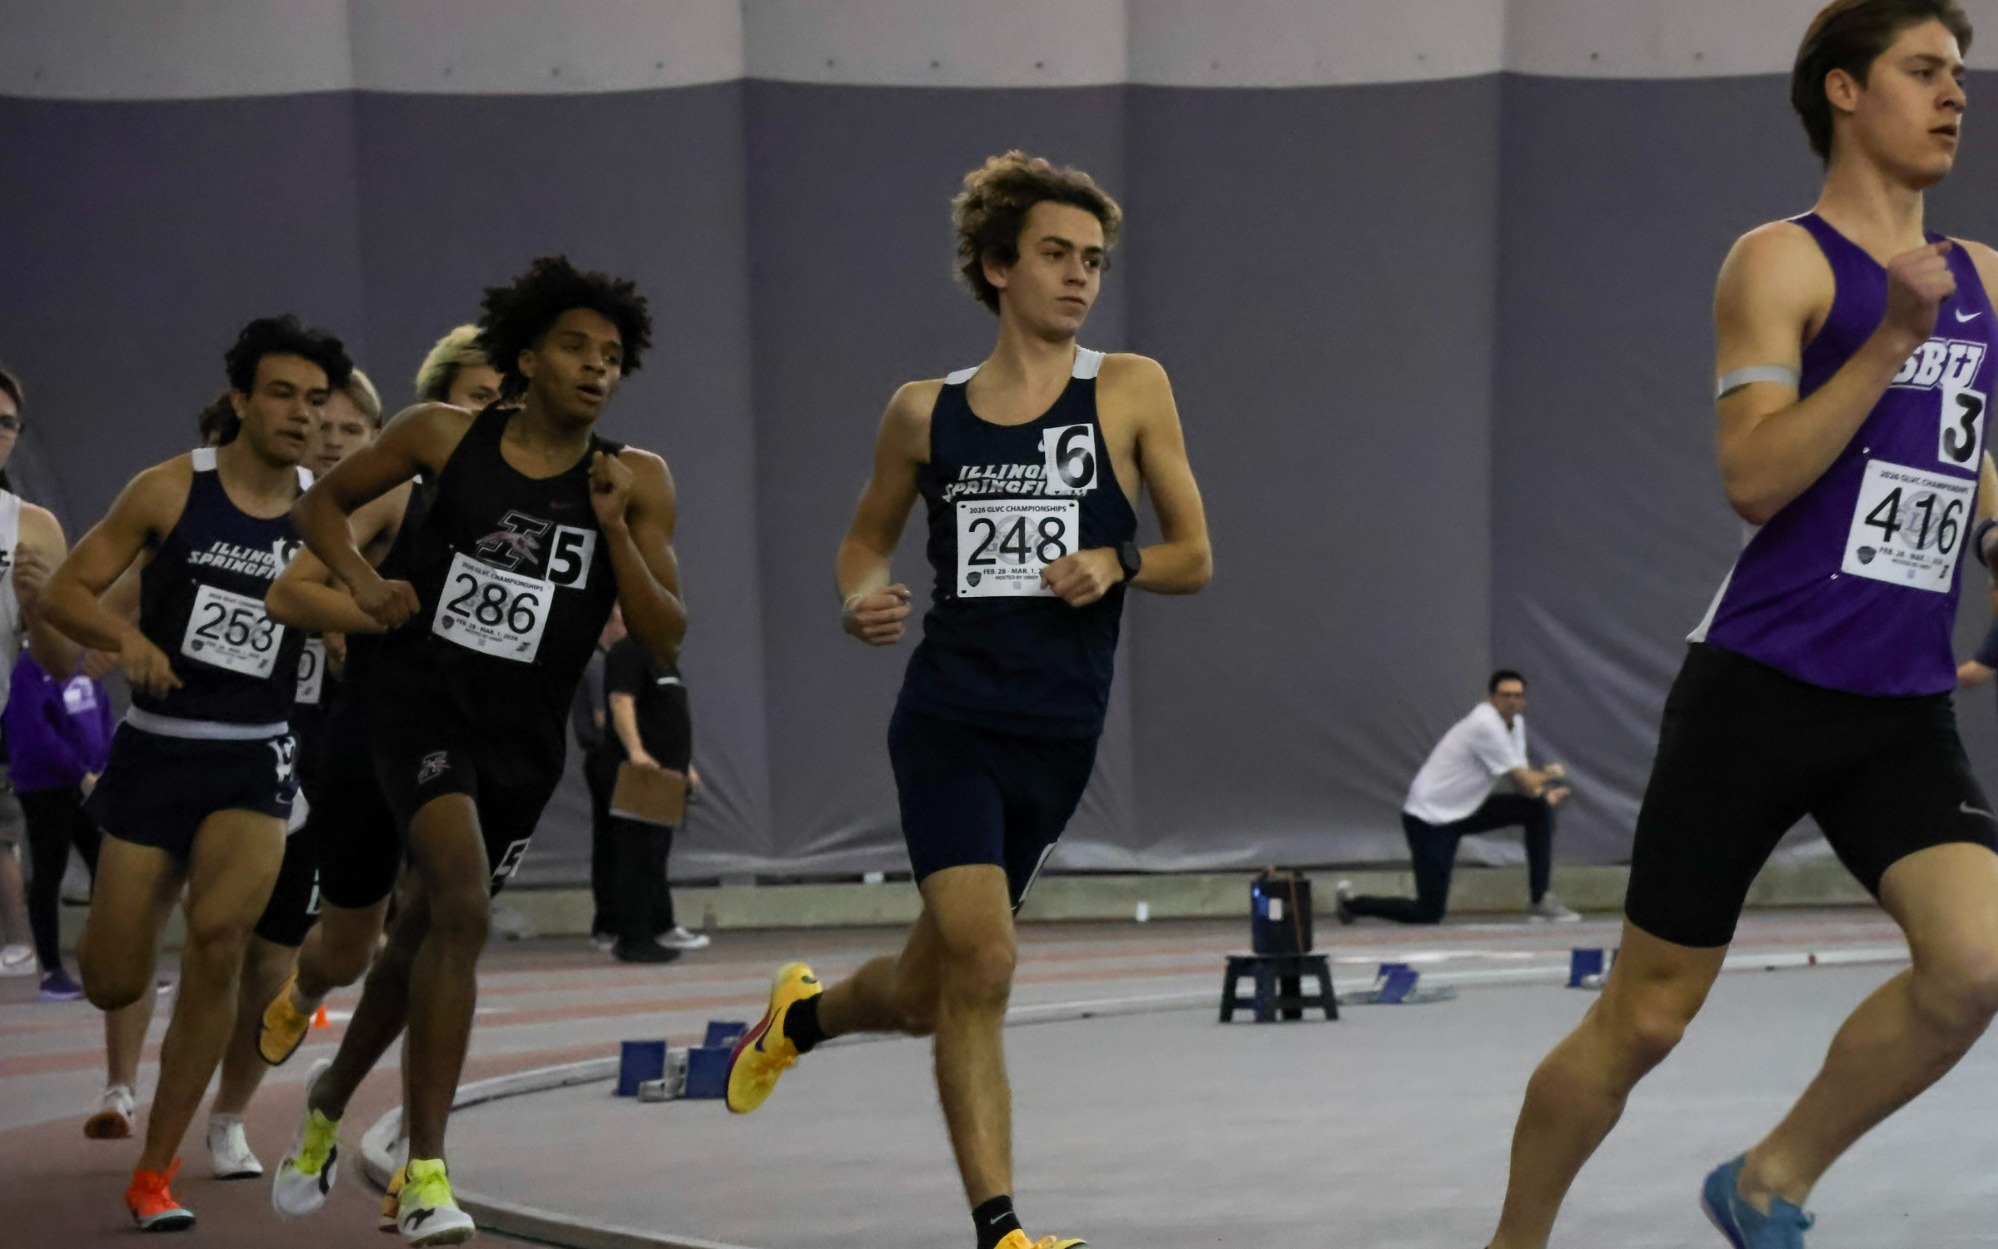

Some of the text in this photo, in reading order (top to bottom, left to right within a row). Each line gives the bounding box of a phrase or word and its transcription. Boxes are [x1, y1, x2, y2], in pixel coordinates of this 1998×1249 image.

[1056, 425, 1095, 488] 6
[1943, 393, 1983, 463] 3
[968, 517, 1068, 566] 248
[1864, 487, 1963, 555] 416
[491, 574, 543, 592] CHAMPIONSHIPS
[548, 531, 584, 585] 5
[195, 602, 275, 652] 253
[446, 573, 539, 634] 286
